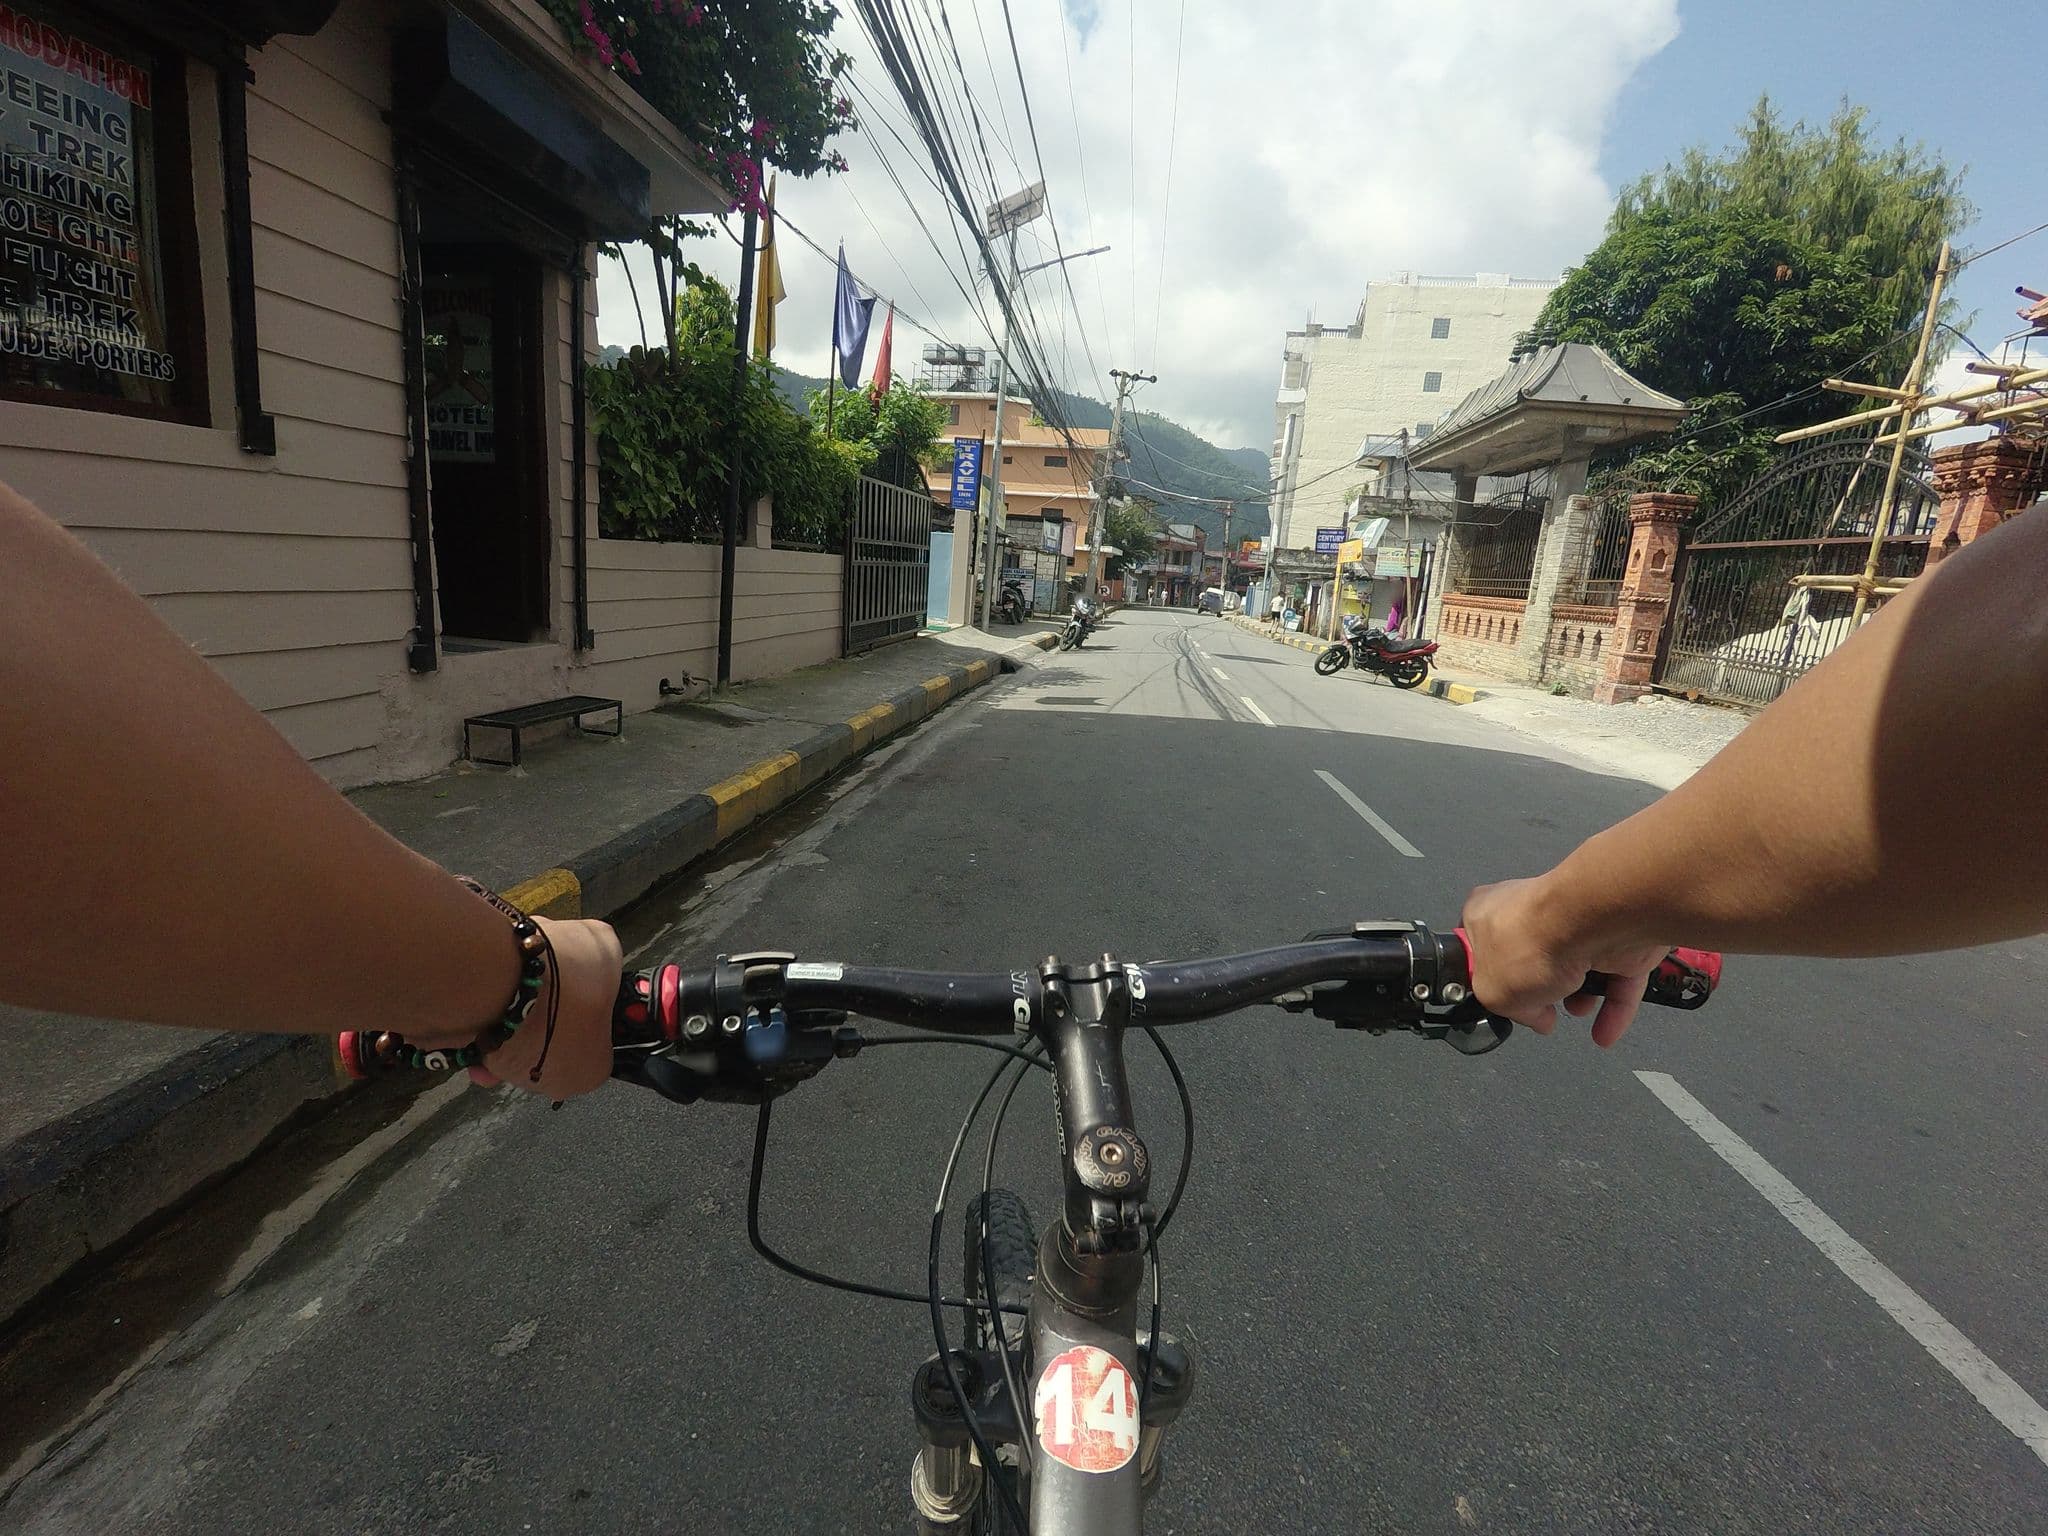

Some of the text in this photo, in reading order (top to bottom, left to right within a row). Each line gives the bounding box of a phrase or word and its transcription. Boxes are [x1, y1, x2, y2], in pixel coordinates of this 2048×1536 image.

[0, 66, 129, 146] EEING
[28, 119, 131, 187] TREK
[2, 152, 134, 226] HIKING
[0, 197, 137, 265] OLIGHT
[38, 287, 141, 337] TREK
[74, 335, 177, 382] PORTERS
[957, 444, 977, 492] TRAVEL
[1317, 534, 1345, 543] CENTURY
[1037, 1363, 1138, 1451] 14
